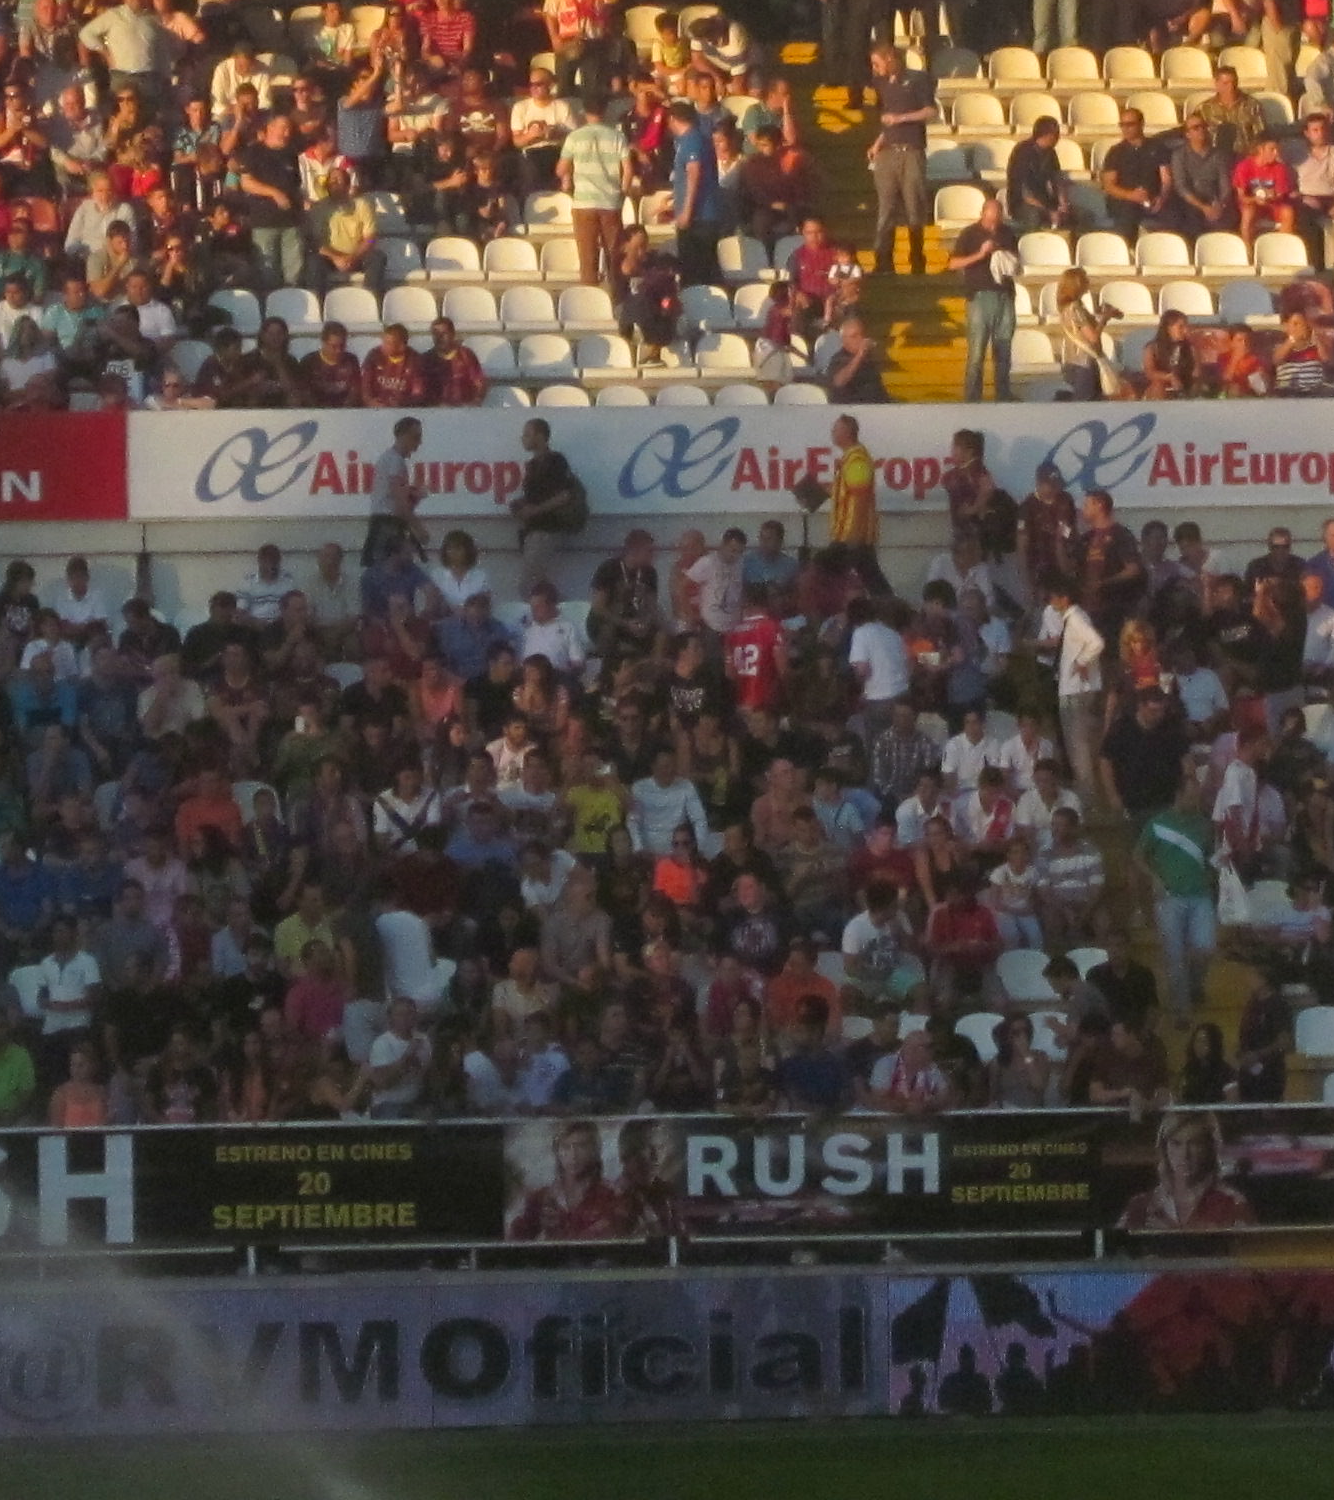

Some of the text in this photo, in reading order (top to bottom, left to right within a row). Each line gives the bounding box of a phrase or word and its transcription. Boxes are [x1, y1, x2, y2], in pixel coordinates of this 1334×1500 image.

[216, 1143, 412, 1162] ESTRENO EN CINES
[952, 1144, 1019, 1157] ESTRENO
[1045, 1142, 1088, 1155] CINES
[687, 1132, 940, 1198] RUSH
[1008, 1162, 1032, 1179] 20
[297, 1172, 331, 1195] 20
[951, 1183, 1090, 1204] SEPTIEMBRE
[212, 1202, 416, 1229] SEPTIEMBRE
